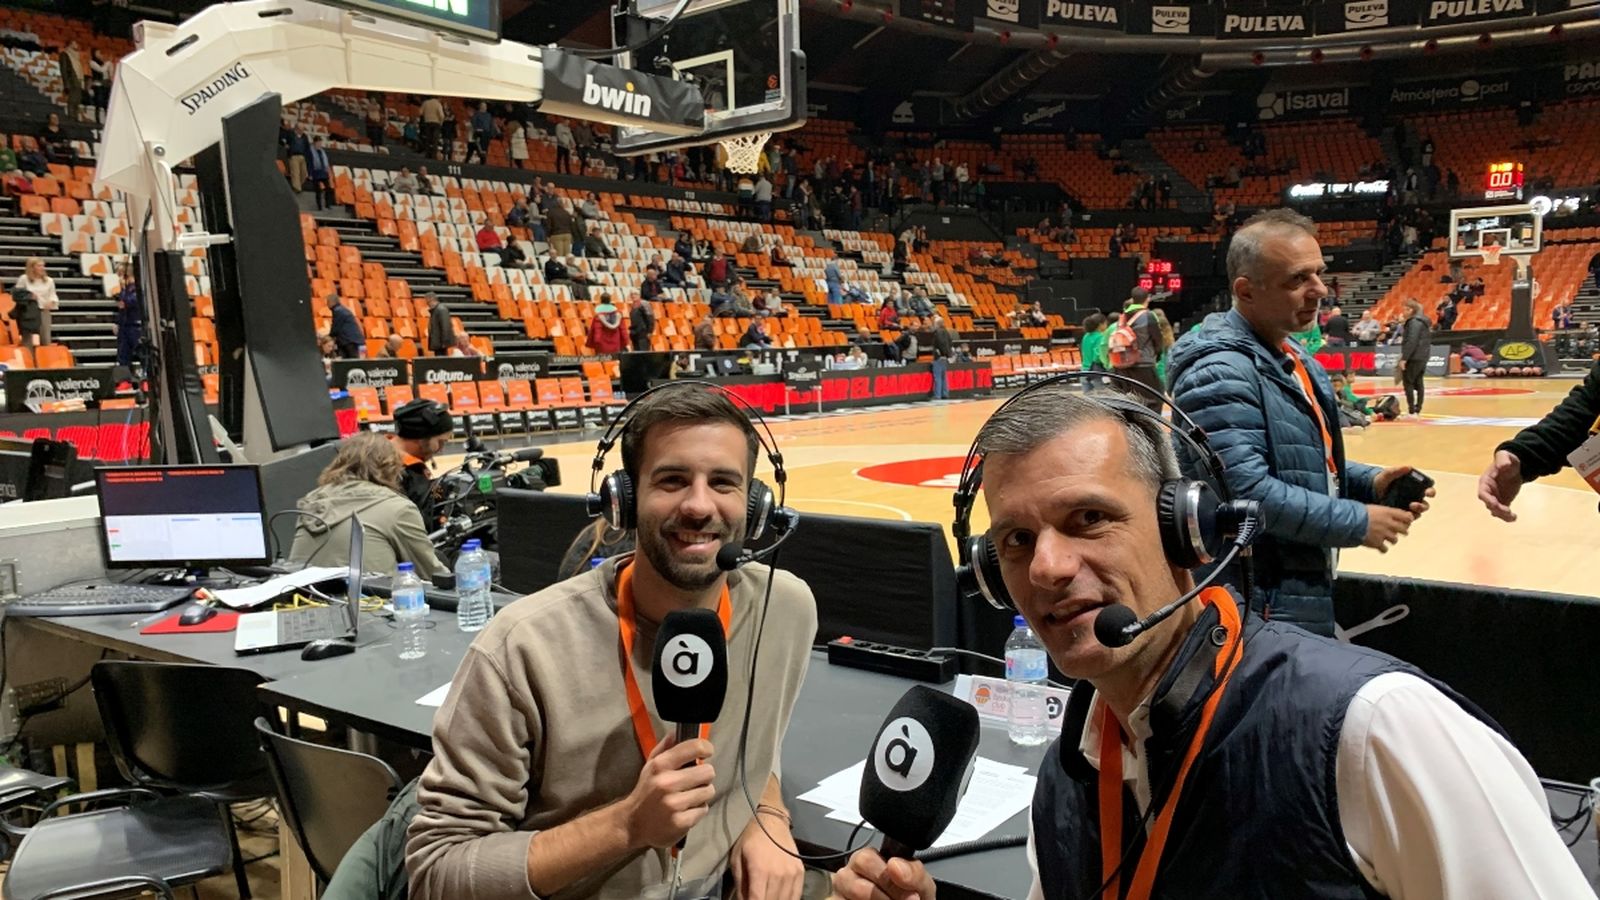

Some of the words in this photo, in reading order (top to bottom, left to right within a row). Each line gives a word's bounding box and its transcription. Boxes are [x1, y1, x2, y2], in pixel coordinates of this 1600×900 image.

[1047, 0, 1118, 23] PULEVA
[1155, 9, 1188, 18] PULEVA
[1348, 4, 1385, 13] PULEVA
[1429, 0, 1525, 19] PULEVA
[1224, 14, 1305, 33] PULEVA
[180, 62, 250, 116] SPALDING
[582, 74, 652, 118] bwin
[1286, 88, 1349, 110] isaval
[367, 367, 399, 378] valencia
[426, 369, 464, 382] Cultura
[514, 363, 541, 373] valencia
[55, 377, 100, 390] valencia
[673, 640, 699, 675] à
[885, 724, 918, 778] à
